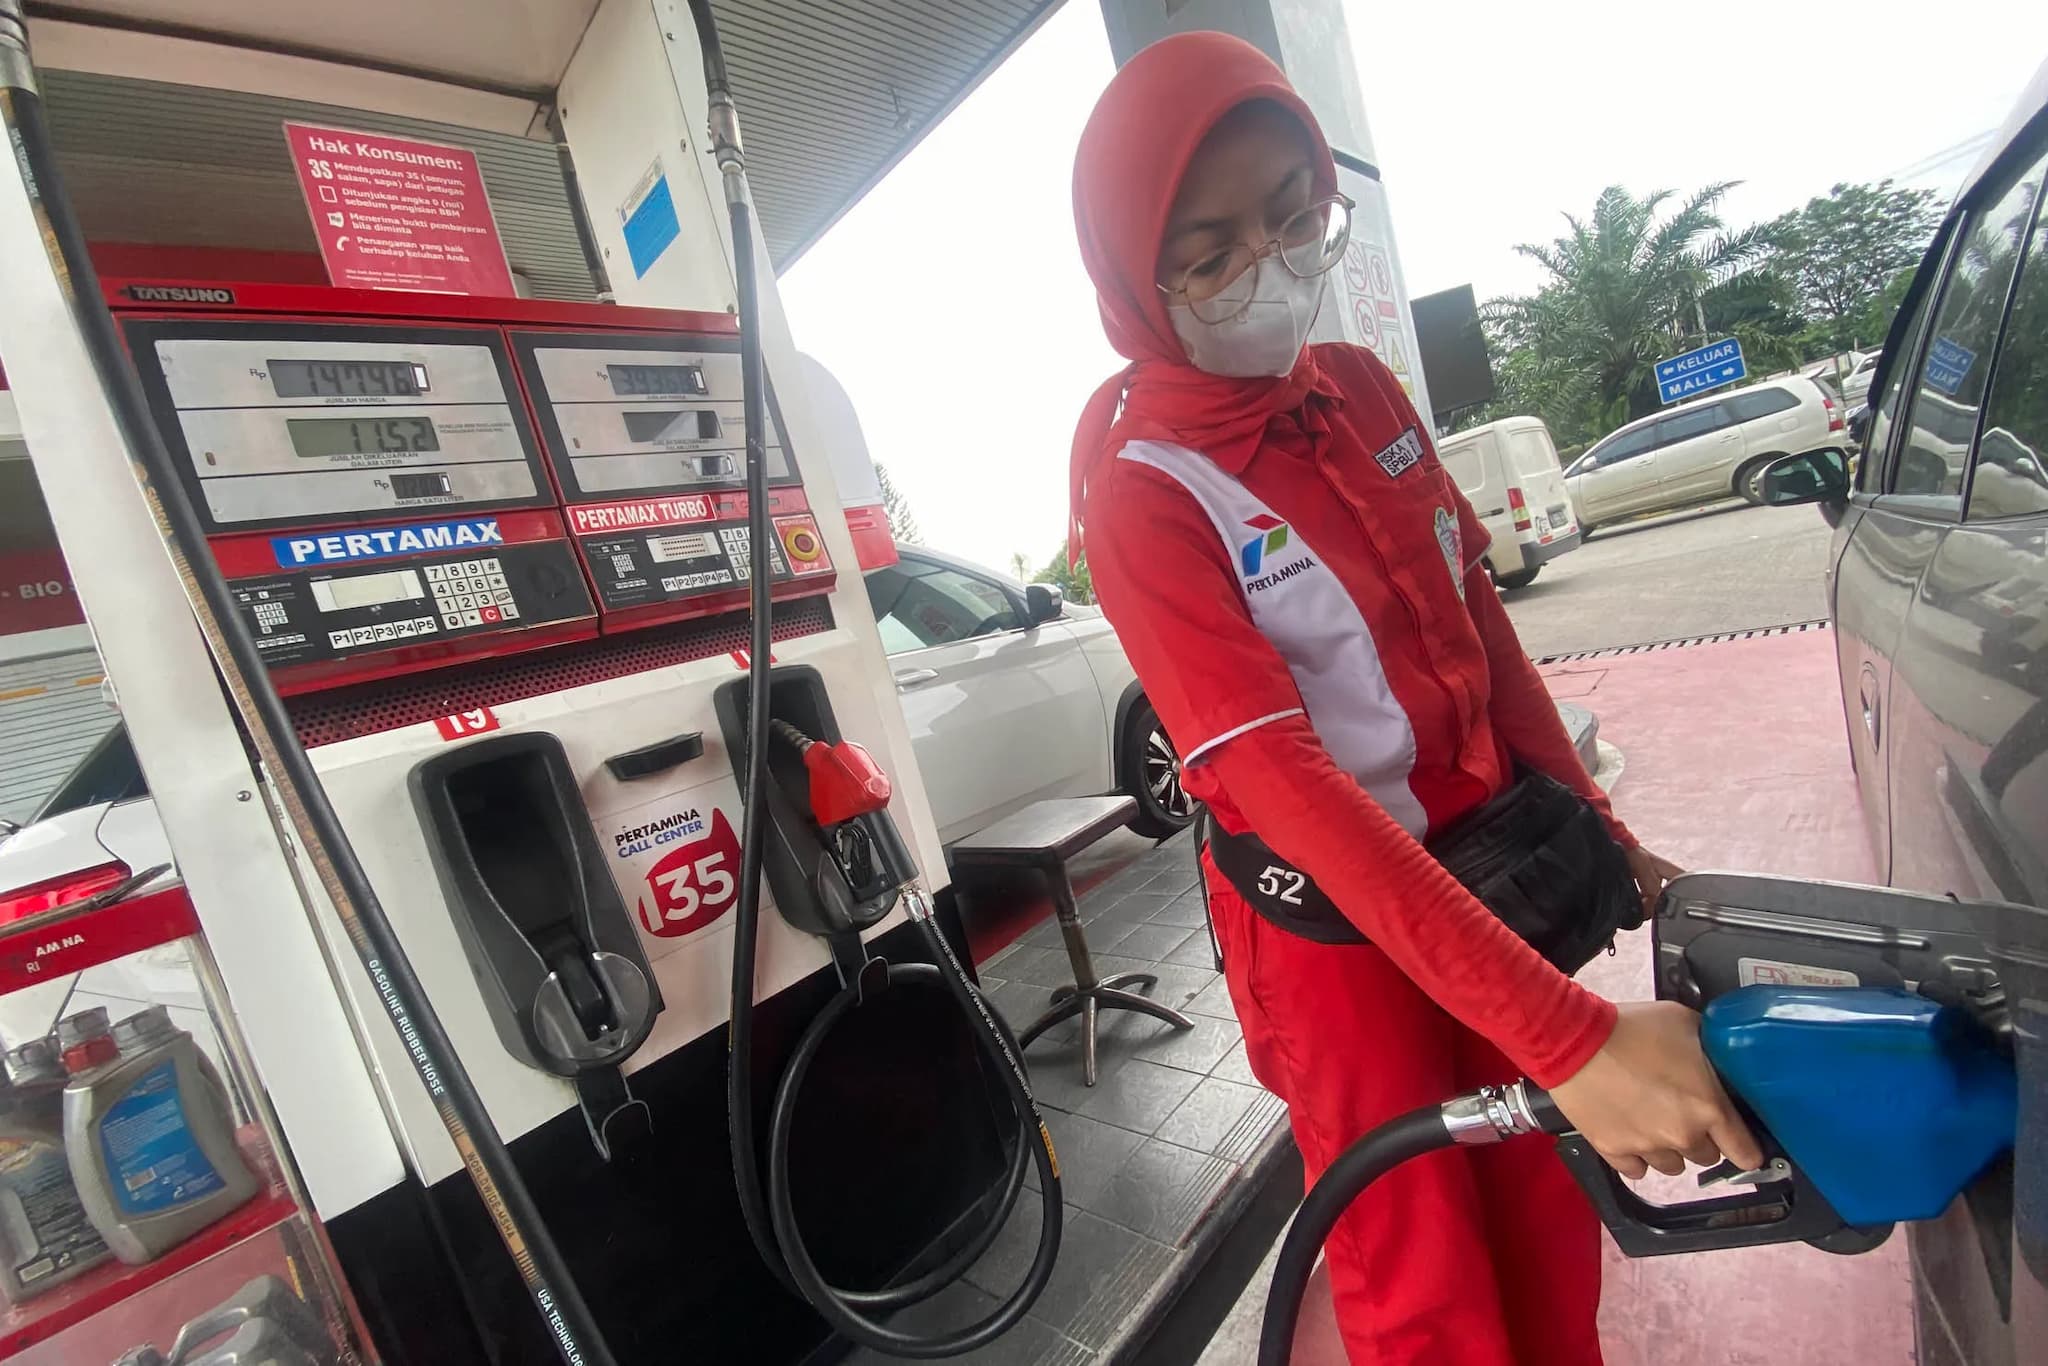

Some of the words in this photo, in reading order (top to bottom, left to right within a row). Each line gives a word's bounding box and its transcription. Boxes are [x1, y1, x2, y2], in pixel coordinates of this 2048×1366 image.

[308, 136, 351, 155] Hak
[356, 144, 463, 171] Konsumen:
[308, 158, 334, 180] 3S
[334, 162, 404, 178] Mendapatkan
[337, 174, 372, 184] salam,
[374, 178, 402, 188] sapa)
[405, 181, 424, 190] dari
[426, 185, 464, 196] petugas
[342, 188, 398, 200] Ditunjukan
[401, 195, 430, 206] angka
[345, 199, 388, 210] sebelum
[390, 204, 436, 215] pengisian
[439, 208, 460, 218] BBM
[349, 212, 400, 225] Menerima
[402, 218, 428, 228] bukti
[430, 222, 487, 234] pembayaran
[352, 221, 372, 230] bila
[374, 224, 412, 234] diminta
[357, 236, 417, 250] Penanganan
[419, 244, 442, 252] yang
[444, 244, 464, 253] baik
[360, 246, 404, 258] terhadap
[406, 250, 444, 260] keluhan
[446, 254, 470, 262] Anda
[132, 286, 230, 303] TATSUNO
[1676, 344, 1734, 372] KELUAR
[249, 368, 267, 381] Rp
[1668, 373, 1717, 396] MALL
[1387, 450, 1414, 474] SPBU
[374, 480, 390, 490] Rp
[577, 507, 658, 530] PERTAMAX
[658, 500, 708, 519] TURBO
[722, 530, 730, 538] 7
[737, 528, 744, 537] 8
[288, 521, 502, 562] PERTAMAX
[729, 544, 736, 552] 4
[430, 568, 438, 578] 7
[450, 566, 460, 576] 8
[468, 564, 478, 574] 9
[692, 574, 704, 584] P3
[705, 572, 716, 582] P4
[718, 570, 730, 580] P5
[739, 570, 746, 578] 0
[1247, 557, 1316, 594] PERTAMINA
[438, 584, 446, 594] 4
[456, 582, 465, 592] 5
[474, 580, 484, 589] 6
[664, 579, 677, 590] P1
[678, 576, 690, 587] P2
[19, 581, 63, 599] BIO
[444, 600, 452, 610] 1
[462, 597, 472, 608] 2
[480, 594, 490, 604] 3
[485, 610, 496, 620] C
[503, 608, 514, 616] L
[376, 627, 394, 638] P3
[397, 624, 414, 634] P4
[417, 620, 434, 631] P5
[333, 634, 350, 644] P1
[354, 631, 372, 642] P2
[447, 708, 486, 733] 19
[615, 808, 700, 846] PERTAMINA
[618, 841, 652, 858] CALL
[655, 820, 704, 844] CENTER
[643, 851, 735, 932] 135
[1258, 866, 1305, 906] 52
[369, 959, 404, 1019] GASOLINE
[398, 1015, 428, 1065] RUBBER
[422, 1062, 444, 1097] HOSE
[538, 1289, 554, 1312] USA
